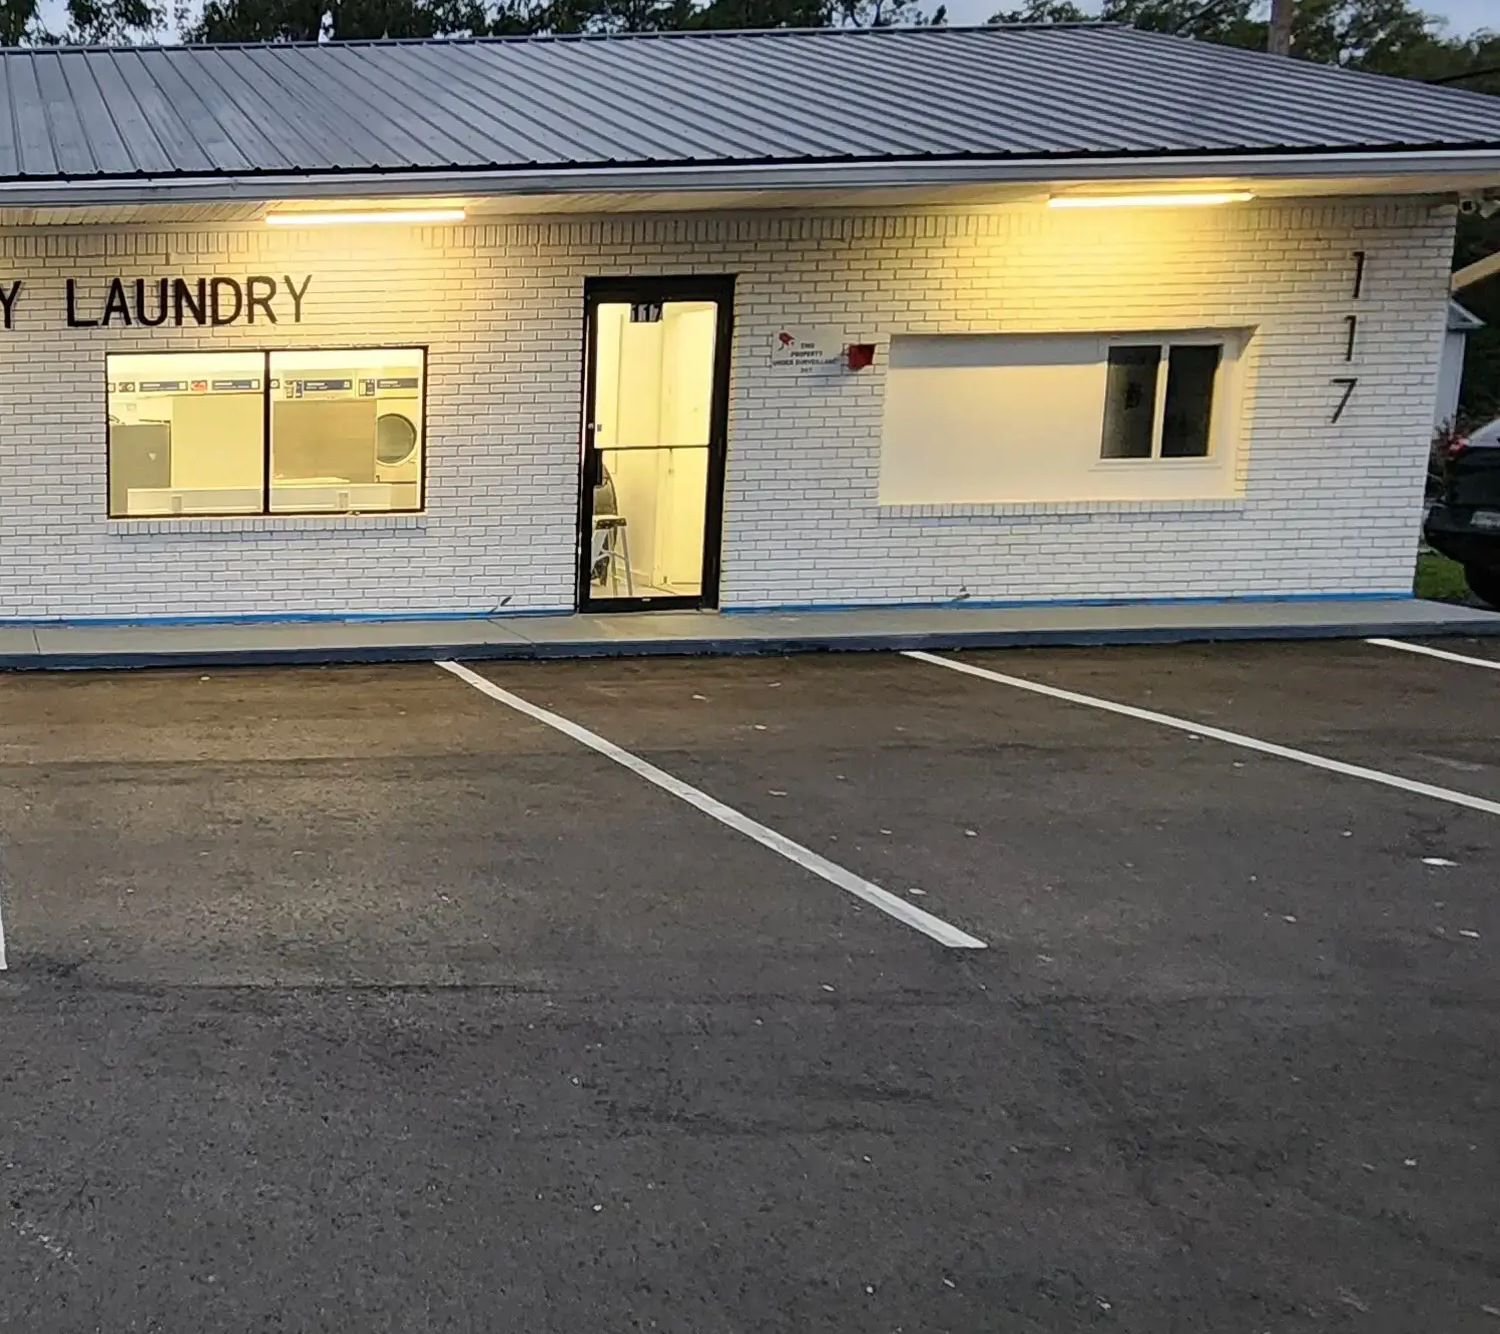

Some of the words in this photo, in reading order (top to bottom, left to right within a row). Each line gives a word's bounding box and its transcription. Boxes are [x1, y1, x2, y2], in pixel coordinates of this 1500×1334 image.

[65, 273, 313, 328] LAUNDRY
[631, 302, 663, 322] 117
[1331, 251, 1366, 424] 117
